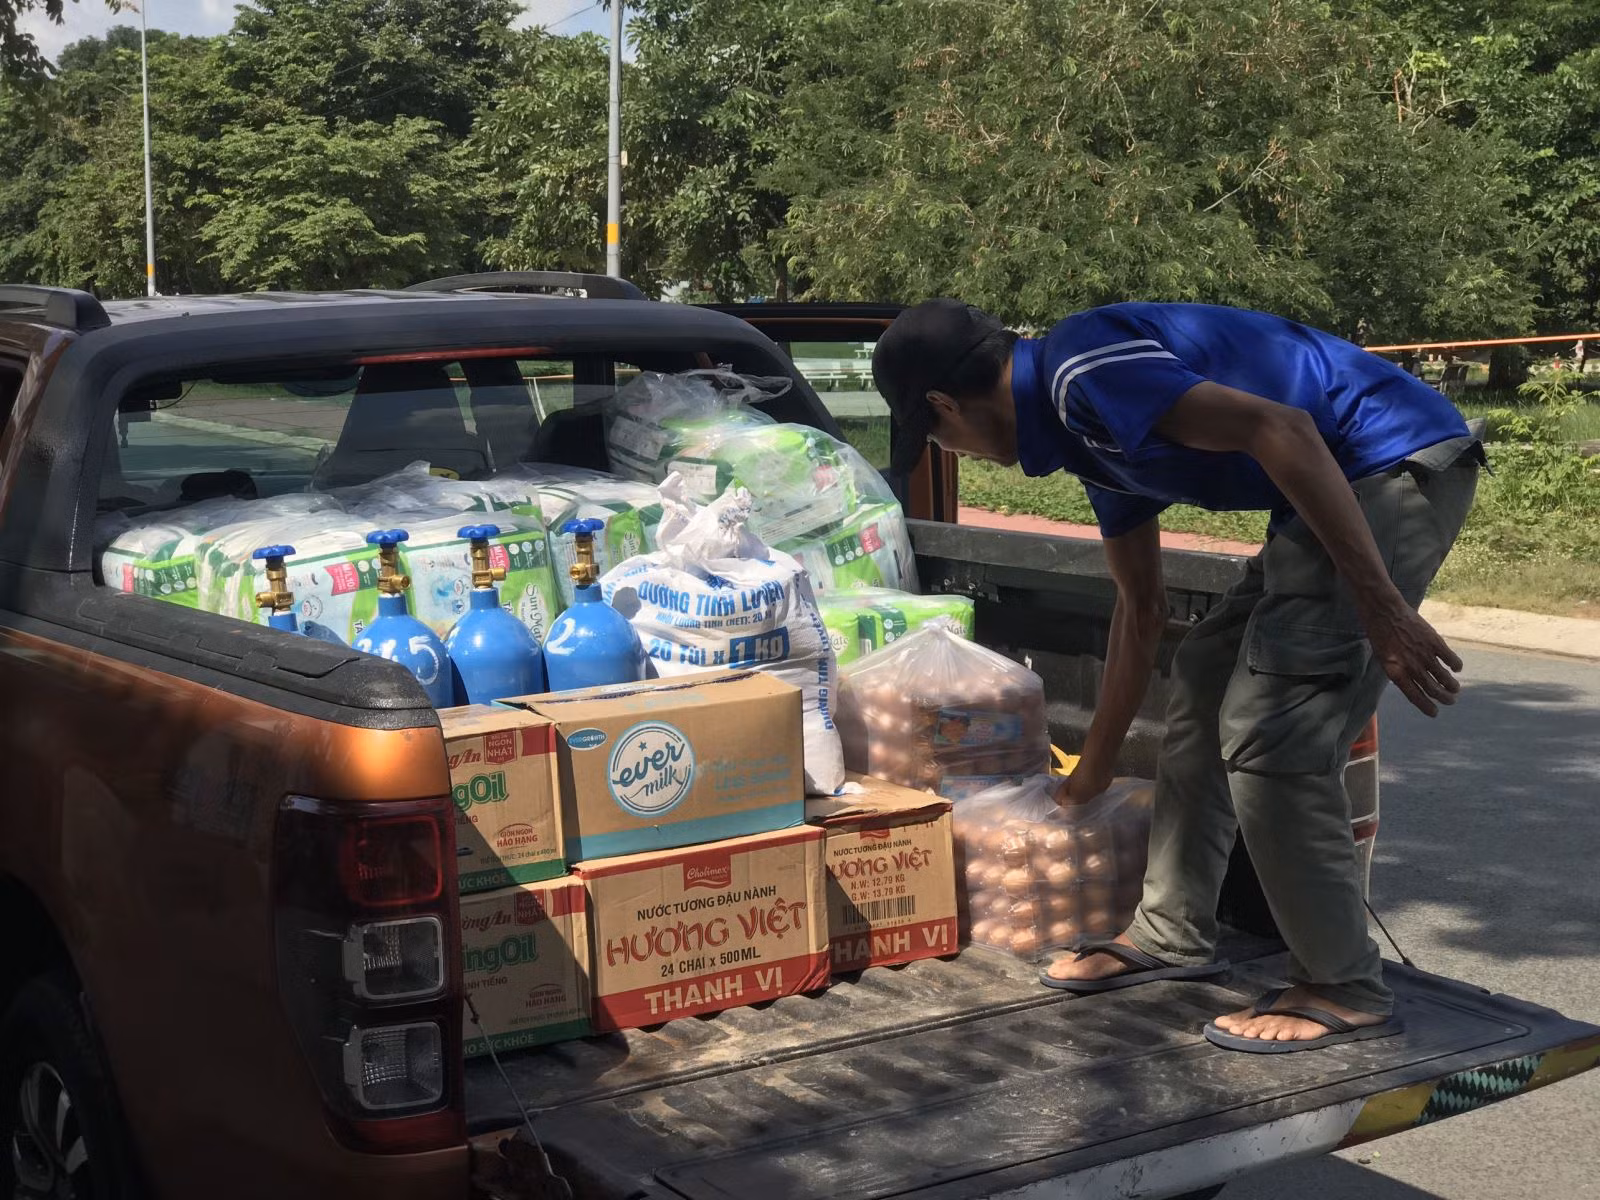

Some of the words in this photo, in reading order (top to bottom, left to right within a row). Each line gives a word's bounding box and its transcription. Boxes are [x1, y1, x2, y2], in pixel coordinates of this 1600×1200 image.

[529, 612, 544, 639] Mat
[547, 617, 577, 656] 2
[648, 638, 672, 662] 20
[735, 641, 750, 663] 1
[612, 741, 685, 787] ever
[630, 764, 684, 798] milk
[829, 854, 888, 881] ƯƠNG
[892, 846, 932, 872] VIỆT
[872, 876, 893, 887] 12.79
[895, 873, 905, 883] KG
[637, 902, 672, 920] NƯỚC
[673, 896, 715, 913] TƯƠNG
[717, 891, 742, 908] ĐẬU
[744, 885, 777, 900] NÀNH
[873, 887, 894, 898] 13.79
[896, 885, 906, 895] KG
[737, 897, 807, 940] VIỆT
[834, 931, 911, 963] HANH
[922, 924, 948, 951] VỊ
[661, 962, 674, 978] 24
[679, 956, 706, 973] CHAI
[709, 956, 716, 967] x
[720, 946, 761, 965] 500ML
[644, 974, 743, 1015] THANH
[755, 966, 783, 995] VỊ
